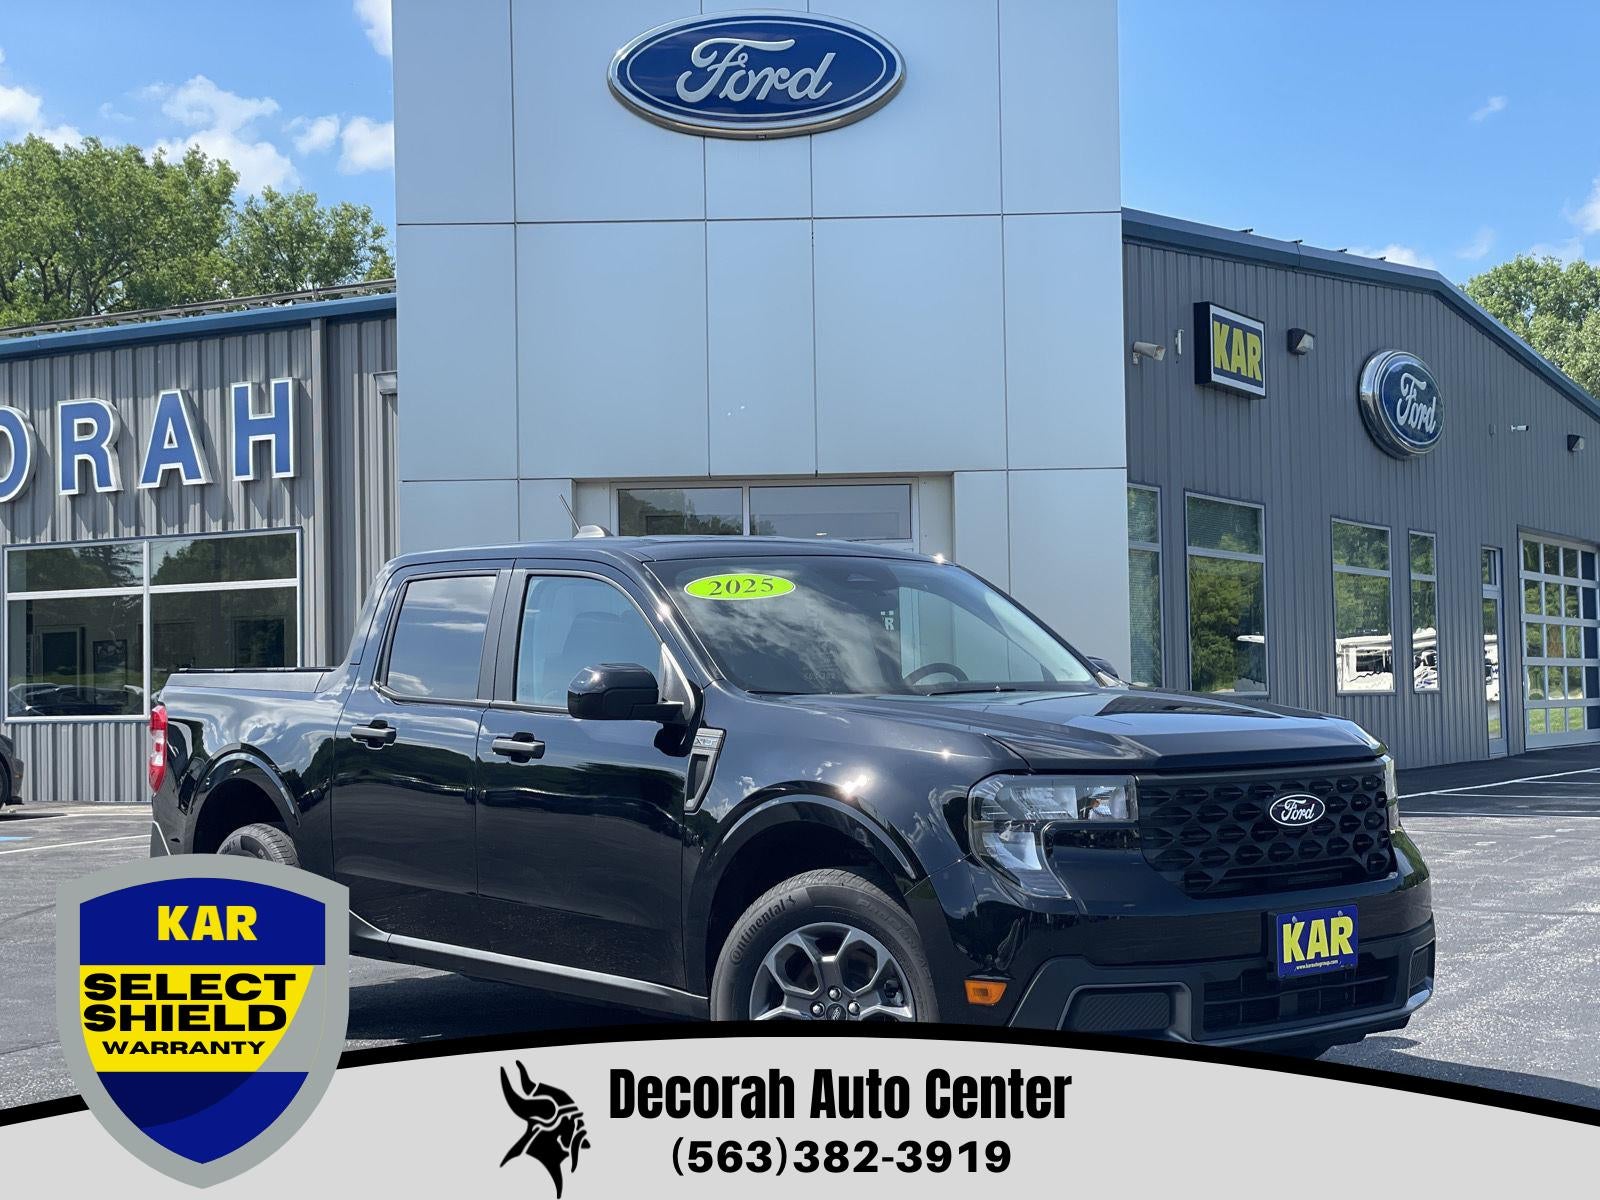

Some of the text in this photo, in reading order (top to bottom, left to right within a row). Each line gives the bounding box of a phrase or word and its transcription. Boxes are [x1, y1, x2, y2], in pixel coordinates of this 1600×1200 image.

[676, 37, 836, 103] Ford
[1213, 320, 1262, 382] KAR
[1396, 372, 1437, 434] Ford
[708, 578, 774, 596] 2025
[1281, 799, 1315, 821] Ford
[730, 899, 786, 965] Continental
[1282, 916, 1354, 964] KAR
